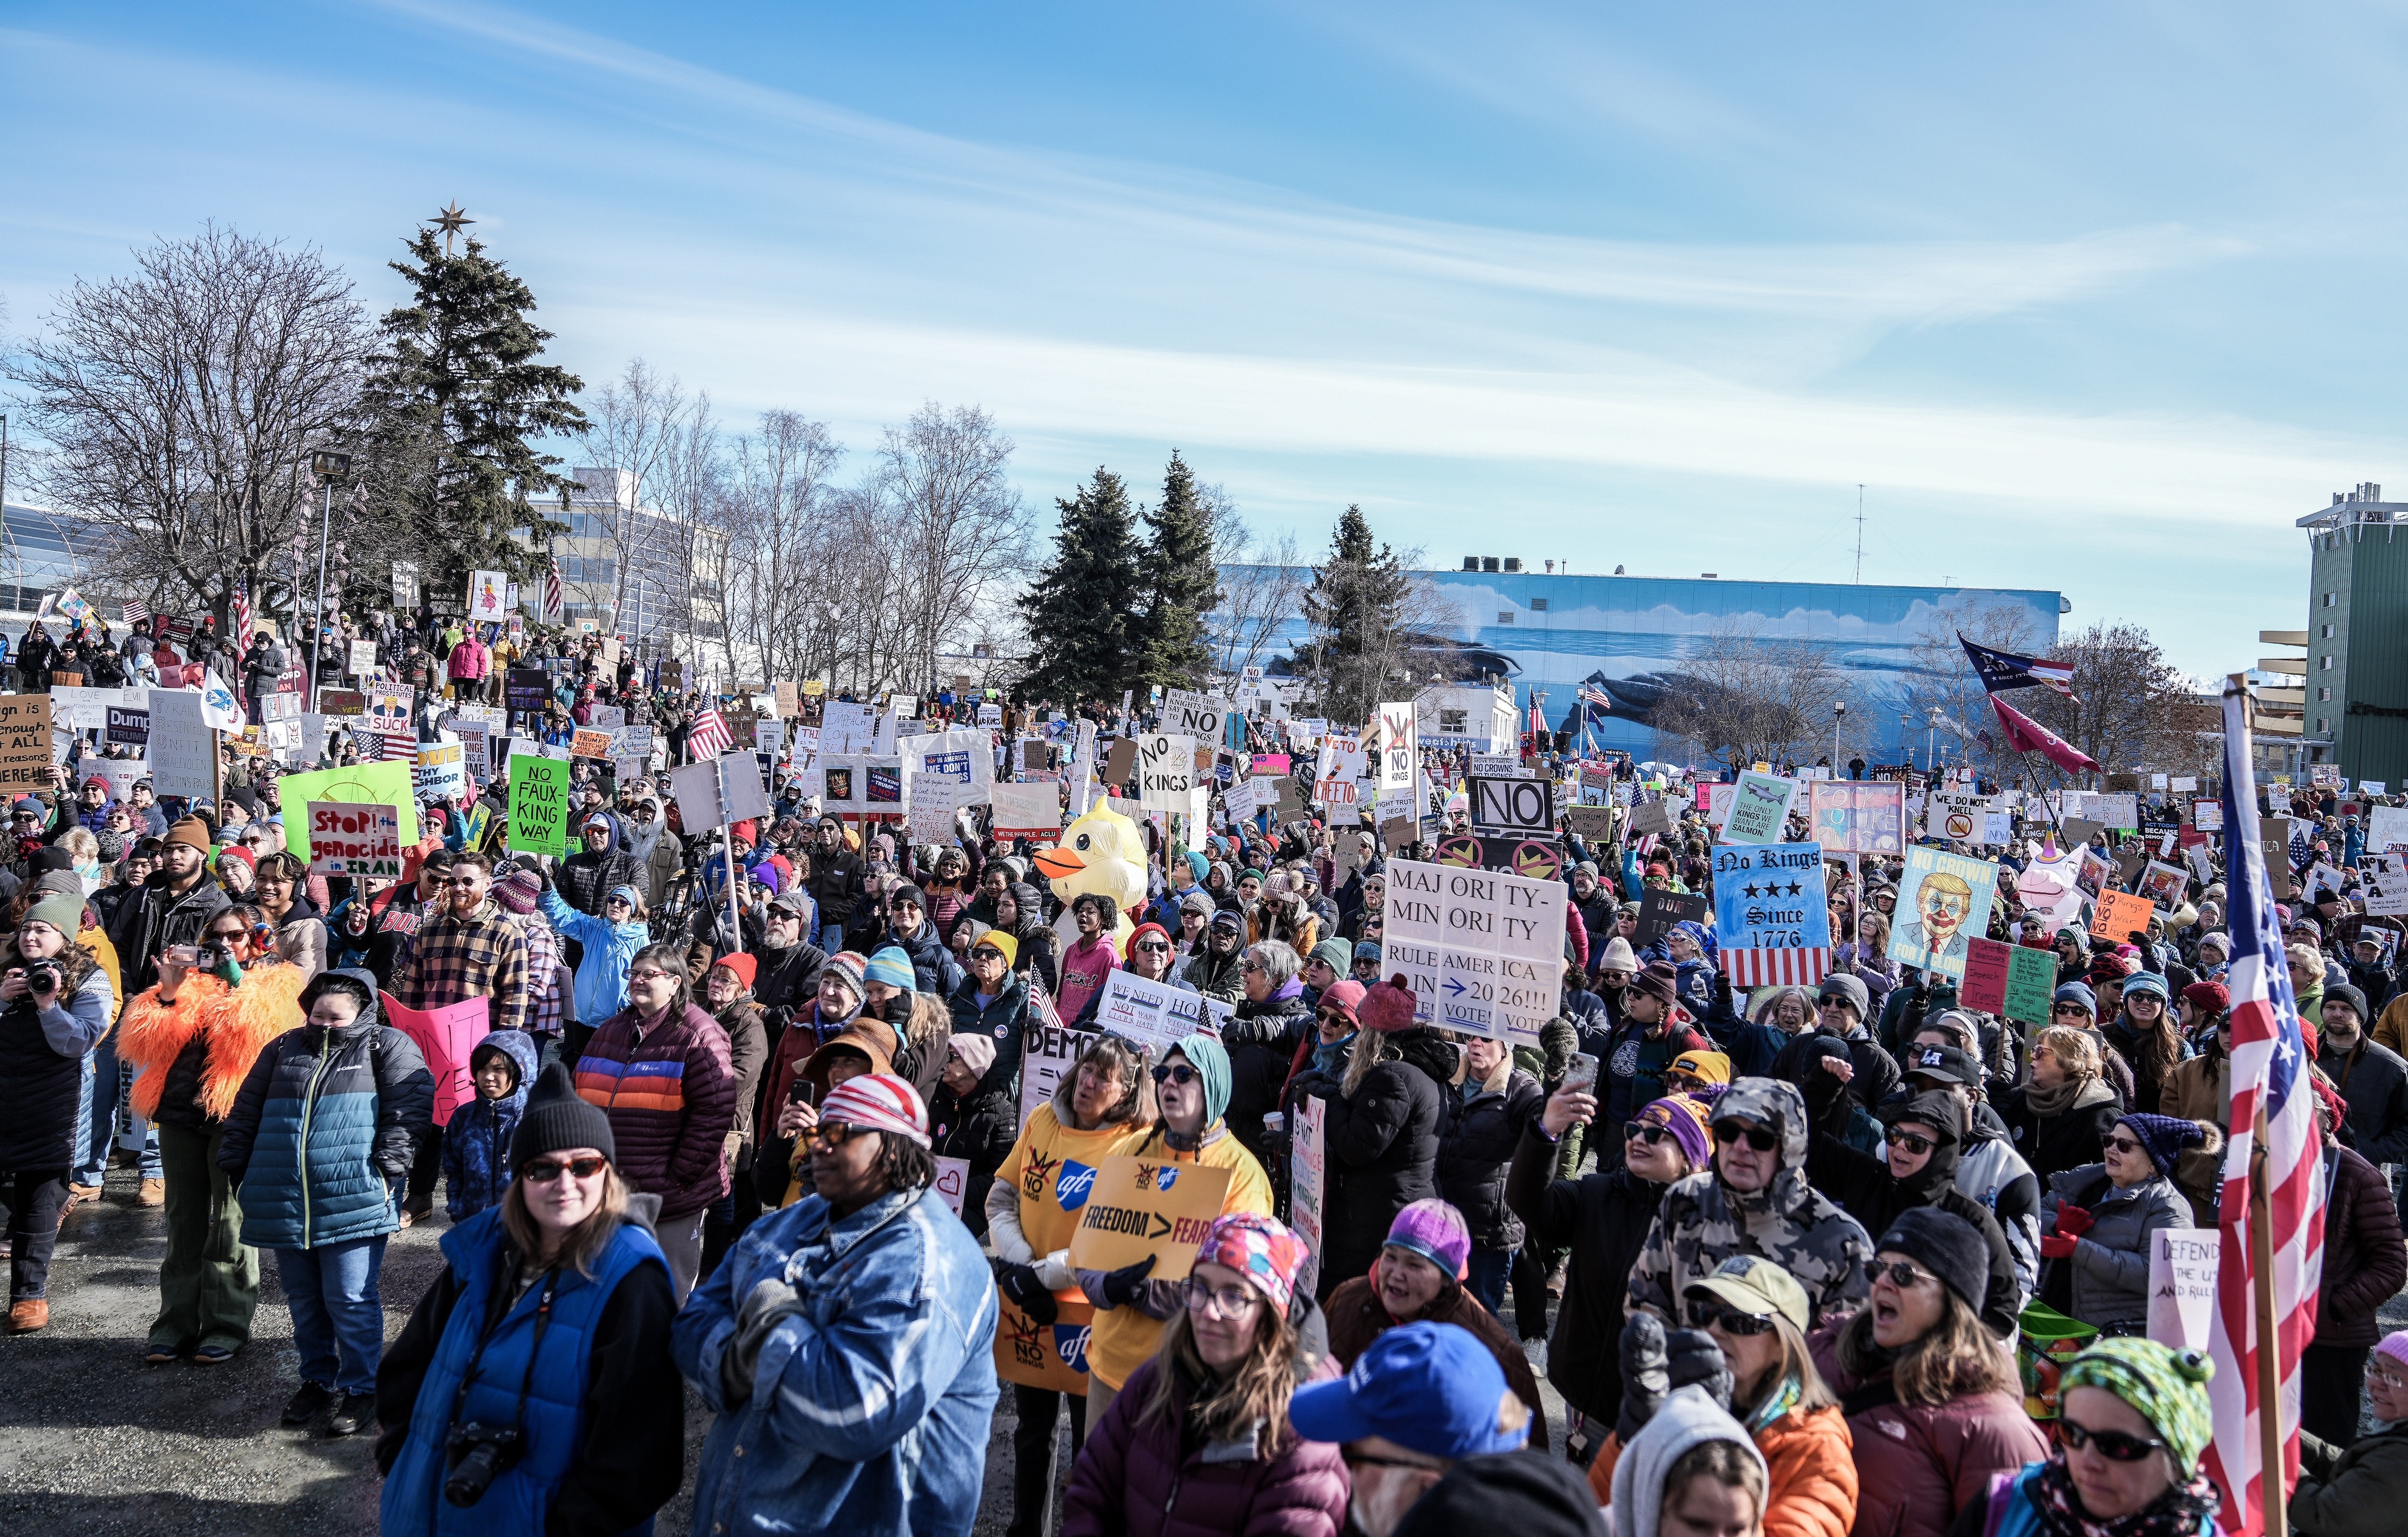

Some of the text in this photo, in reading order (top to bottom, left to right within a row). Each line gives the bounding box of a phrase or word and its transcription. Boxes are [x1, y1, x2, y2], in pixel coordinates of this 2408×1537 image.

[1248, 668, 1259, 676] NO
[71, 688, 100, 699] LOVE
[376, 682, 413, 693] POLITICAL
[804, 684, 820, 693] SHAME
[123, 688, 144, 702] EVIL
[375, 689, 412, 699] PROSTITUTES
[26, 702, 39, 714] is
[341, 706, 362, 714] VOTE
[1169, 699, 1221, 714] KNIGHTS WHO
[110, 709, 150, 732] Dump
[740, 713, 753, 721] what
[825, 713, 868, 726] IMPEACH
[978, 716, 1001, 726] NO KINGS
[1168, 708, 1217, 732] TO NO
[155, 715, 208, 737] RESENTFUL
[373, 717, 409, 732] SUCK
[626, 726, 651, 735] PUBLIC
[110, 729, 148, 741] TRUMP
[612, 729, 622, 741] WE
[739, 732, 749, 741] like
[824, 729, 868, 741] CONVICT
[1183, 728, 1215, 742] KINGS!
[11, 737, 44, 749] ALL
[156, 734, 200, 754] UNFIT
[577, 741, 607, 750] BRITCHES
[823, 742, 863, 754] REMOVE
[1025, 743, 1045, 751] TRUMP
[1324, 736, 1356, 754] VETO
[4, 753, 49, 763] reasons
[943, 754, 969, 763] AMERICA,
[1141, 737, 1169, 768] NO
[1325, 752, 1344, 765] the
[156, 751, 212, 771] MALEVOLENT
[943, 761, 968, 773] DON'T
[1391, 752, 1408, 771] NO
[528, 766, 552, 780] NO
[1304, 767, 1313, 778] NO
[1473, 764, 1513, 773] NO CROWNS
[1144, 771, 1188, 792] KINGS
[1300, 774, 1313, 786] TRUMP
[1391, 772, 1408, 782] KINGS
[1583, 773, 1607, 785] RESIST
[876, 780, 894, 790] TRUMP
[2112, 780, 2135, 789] KINGS!
[519, 782, 564, 804] FAUX-
[878, 787, 896, 798] NOT
[1313, 779, 1355, 804] CHEETO
[912, 796, 935, 804] VOTED
[1478, 781, 1543, 825] NO
[1816, 783, 1898, 813] ROCKY
[1934, 793, 1986, 808] WE DO NOT
[2082, 796, 2135, 806] STOP FASCISM
[517, 802, 558, 824] KING
[1634, 804, 1657, 816] STOP
[1740, 802, 1773, 817] THE ONLY
[1948, 805, 1974, 816] KNEEL
[380, 816, 397, 827] the
[914, 813, 948, 822] FASCIST
[1281, 812, 1297, 823] RIGHT
[1737, 809, 1773, 823] KINGS WE
[1818, 808, 1900, 831] NO LIKE
[914, 821, 949, 830] RAPIST
[1635, 817, 1665, 828] CORRUPTION
[1734, 816, 1770, 831] WANT ARE
[2022, 823, 2034, 831] NO
[519, 821, 552, 841] WAY
[918, 829, 948, 839] LYING
[1576, 828, 1601, 837] WORLD
[1732, 824, 1765, 837] SALMON.
[2021, 829, 2045, 838] KINGS
[917, 837, 952, 845] LOSER
[1816, 826, 1875, 853] KINGS
[311, 838, 398, 862] genocide
[1338, 851, 1353, 864] ICE
[1714, 849, 1820, 872] No Kings
[331, 861, 399, 876] in IRAN
[2378, 858, 2399, 873] KING
[2362, 871, 2404, 884] BELONGS
[1746, 906, 1804, 926] Since
[1752, 931, 1801, 948] 1776
[1388, 945, 1438, 967] RULE
[1414, 973, 1435, 995] IN
[1444, 1003, 1491, 1024] VOTE!
[1083, 1205, 1150, 1237] FREEDOM
